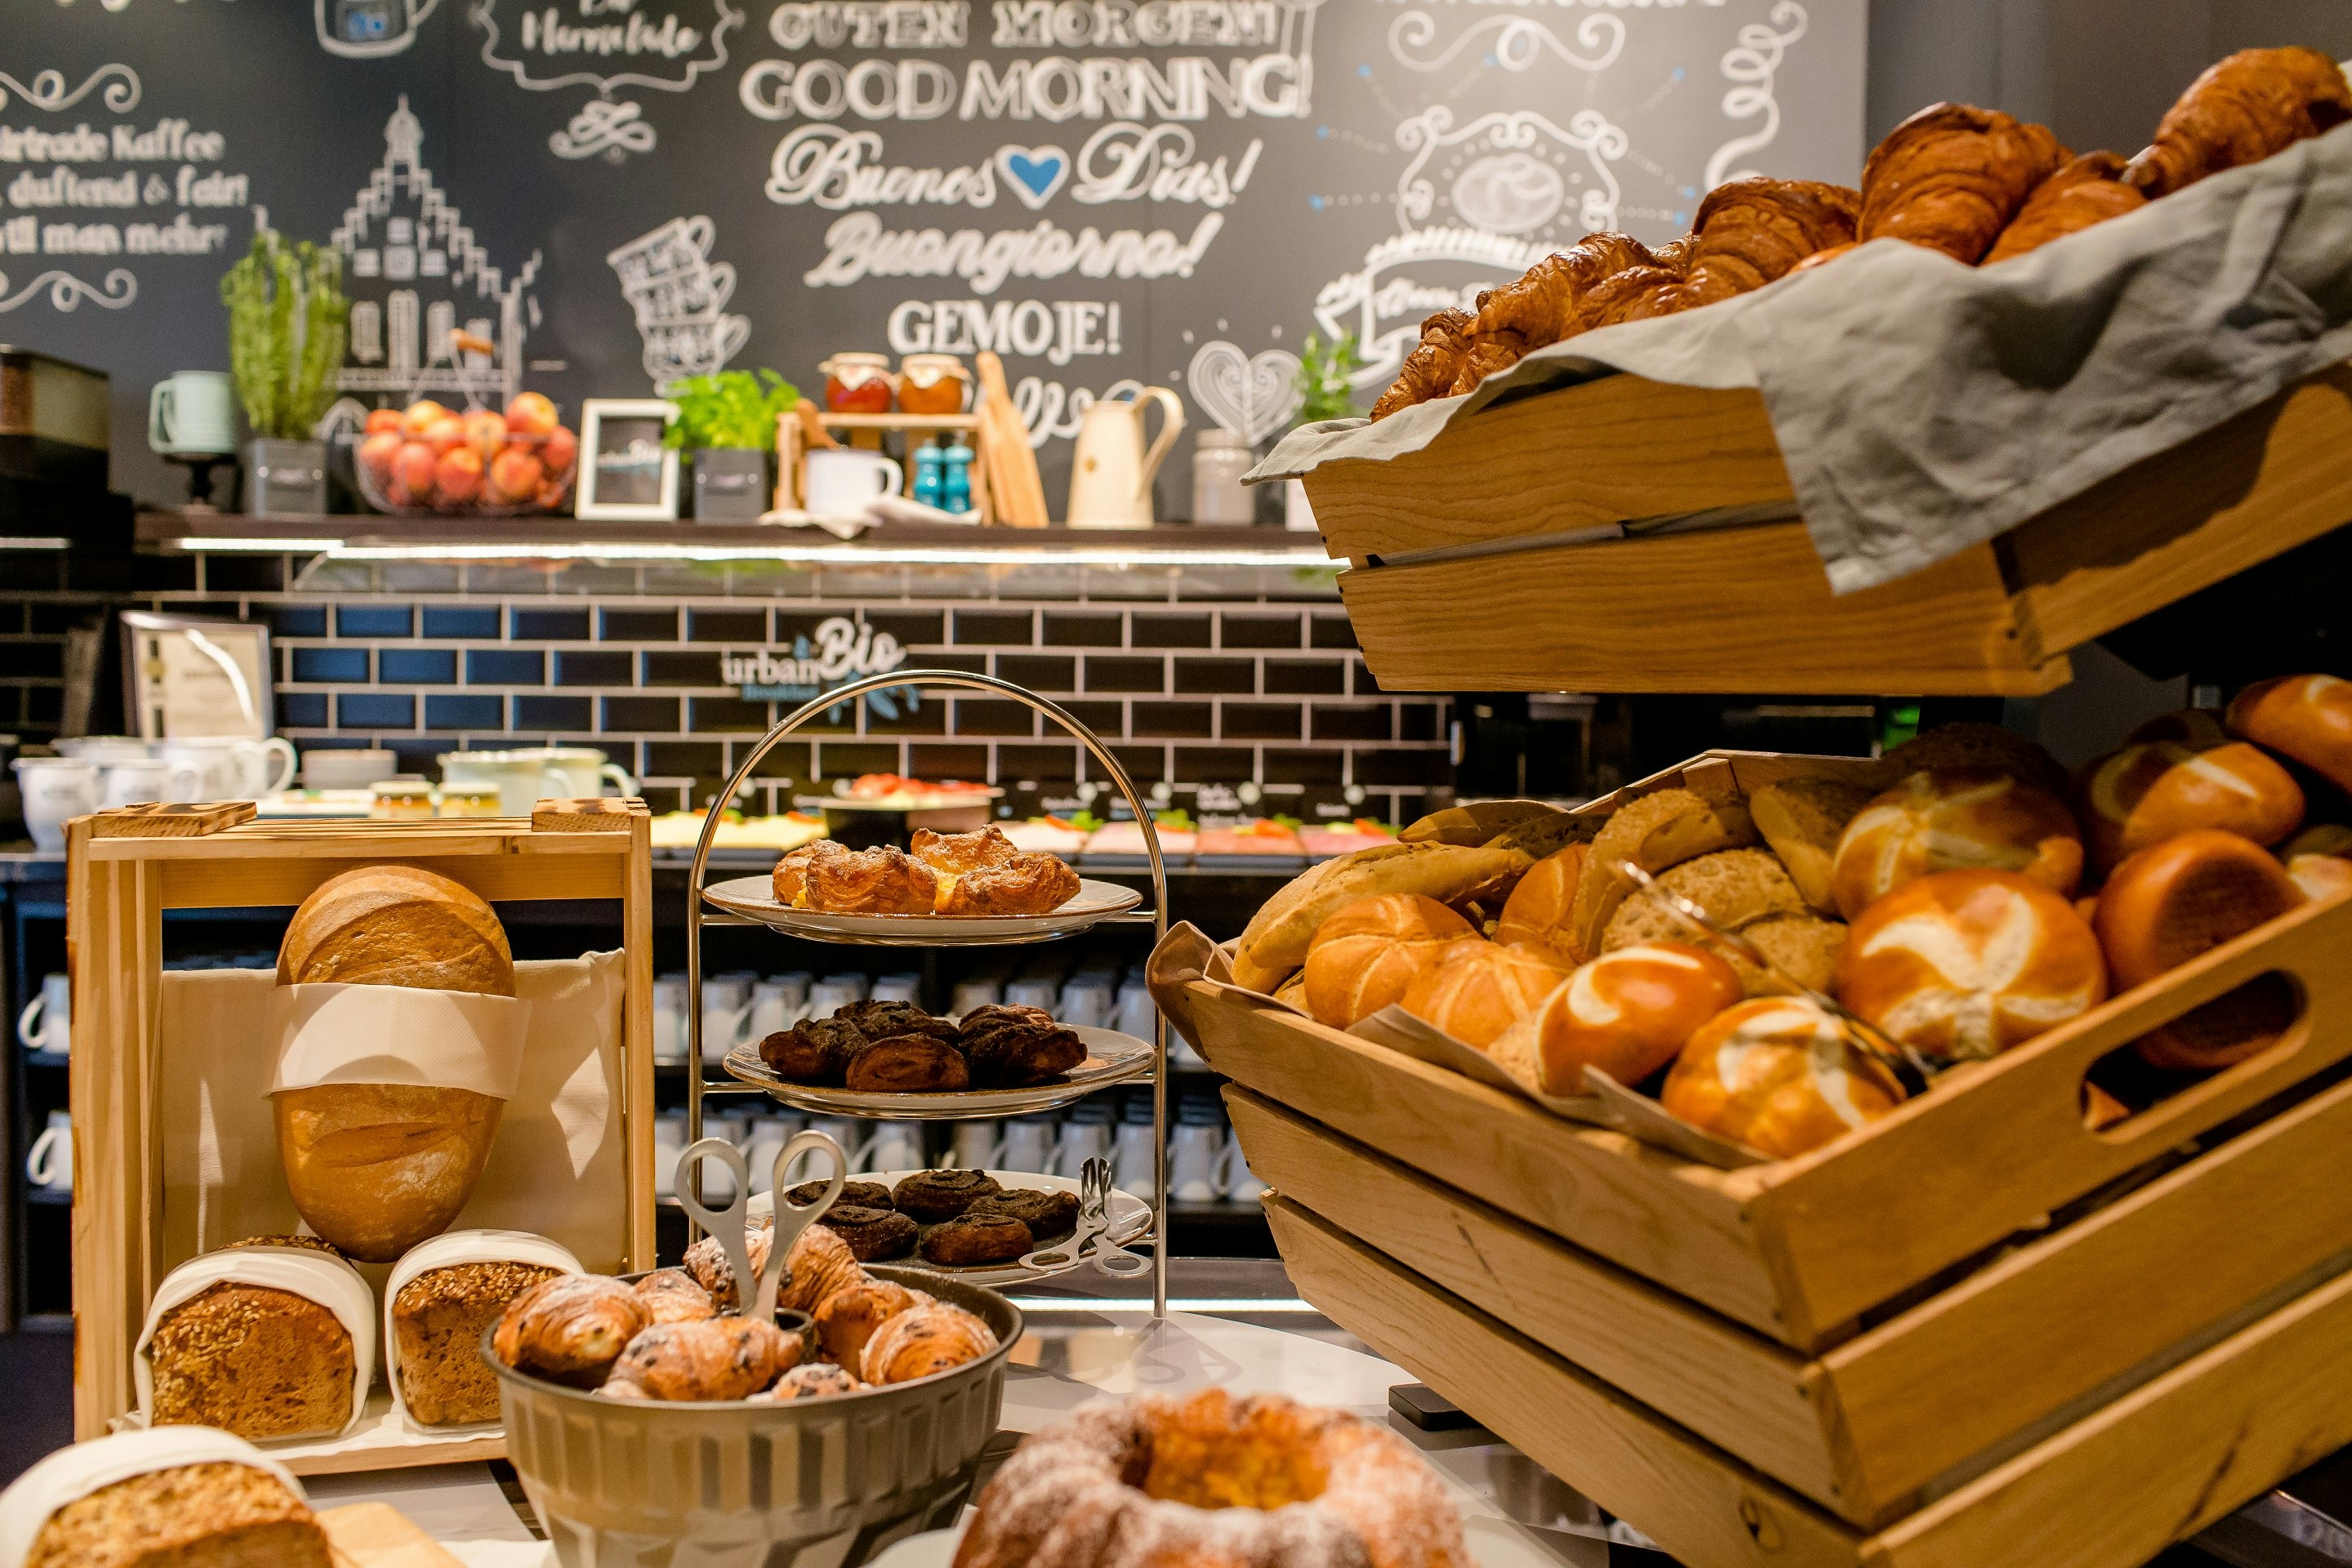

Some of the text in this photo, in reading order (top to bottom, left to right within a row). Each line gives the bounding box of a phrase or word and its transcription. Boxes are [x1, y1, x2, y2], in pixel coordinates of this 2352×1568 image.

[769, 1, 971, 49] GUTEN
[739, 58, 957, 120] GOOD
[111, 118, 225, 162] Kaffee
[764, 122, 997, 210] Buenos
[42, 222, 122, 255] man
[804, 211, 1224, 294] Buongiorno!
[888, 300, 1121, 365] GEMOJE!
